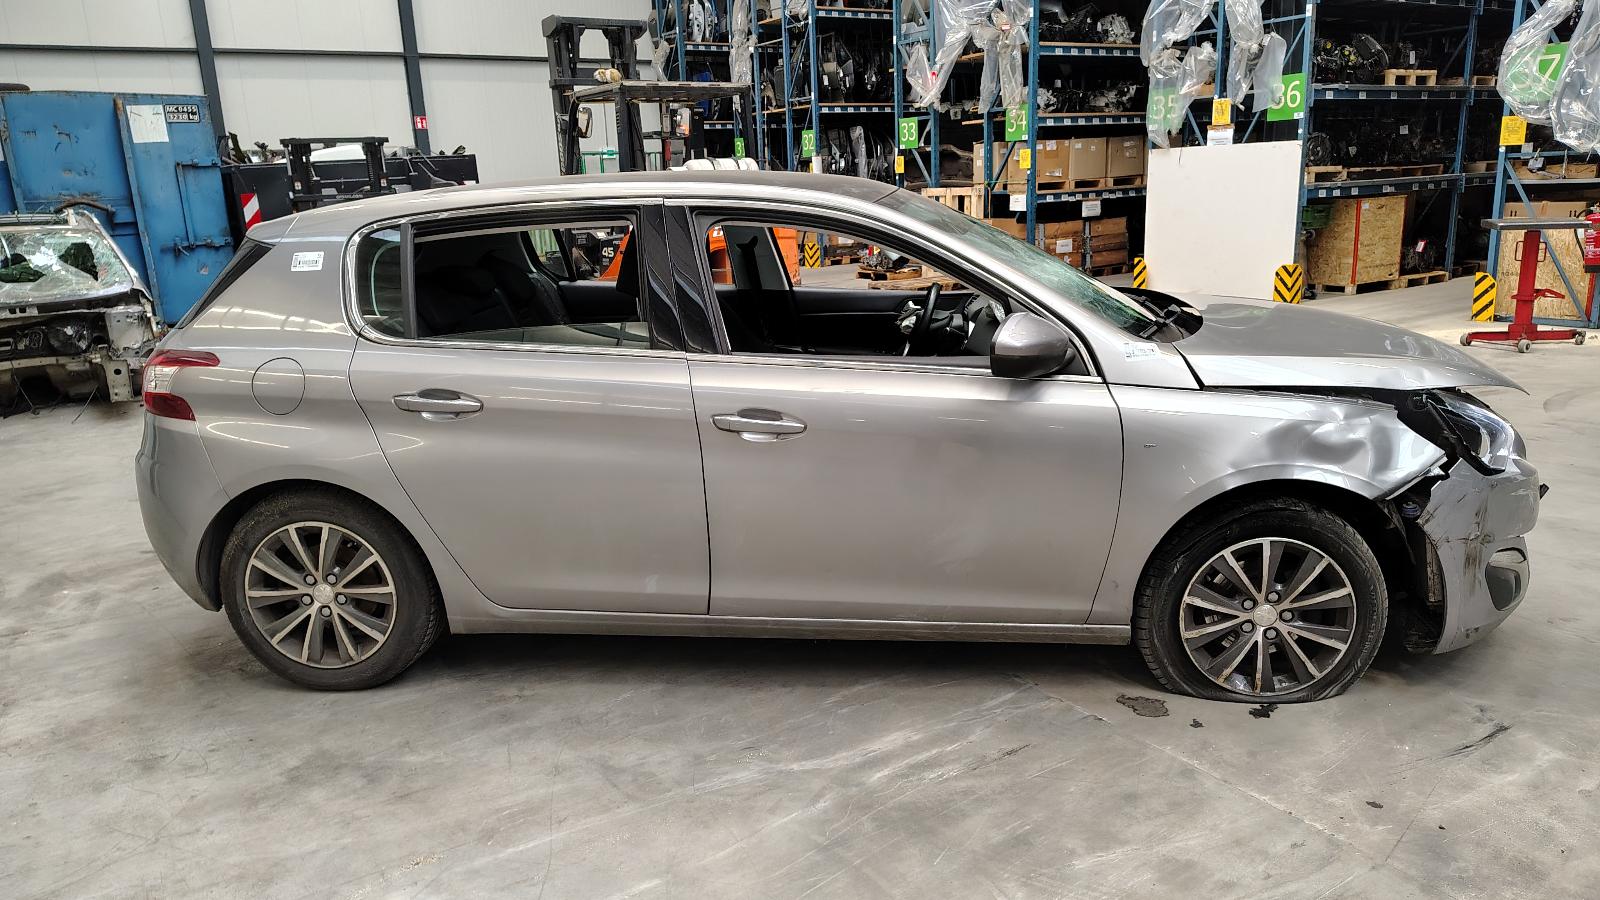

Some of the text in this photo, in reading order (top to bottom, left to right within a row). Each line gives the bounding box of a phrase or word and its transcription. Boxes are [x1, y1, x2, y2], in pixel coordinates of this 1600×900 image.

[1270, 80, 1301, 109] 36
[1153, 95, 1178, 120] 35
[1007, 109, 1027, 132] 34
[803, 134, 815, 150] 32
[901, 122, 916, 141] 33
[601, 246, 614, 257] 45
